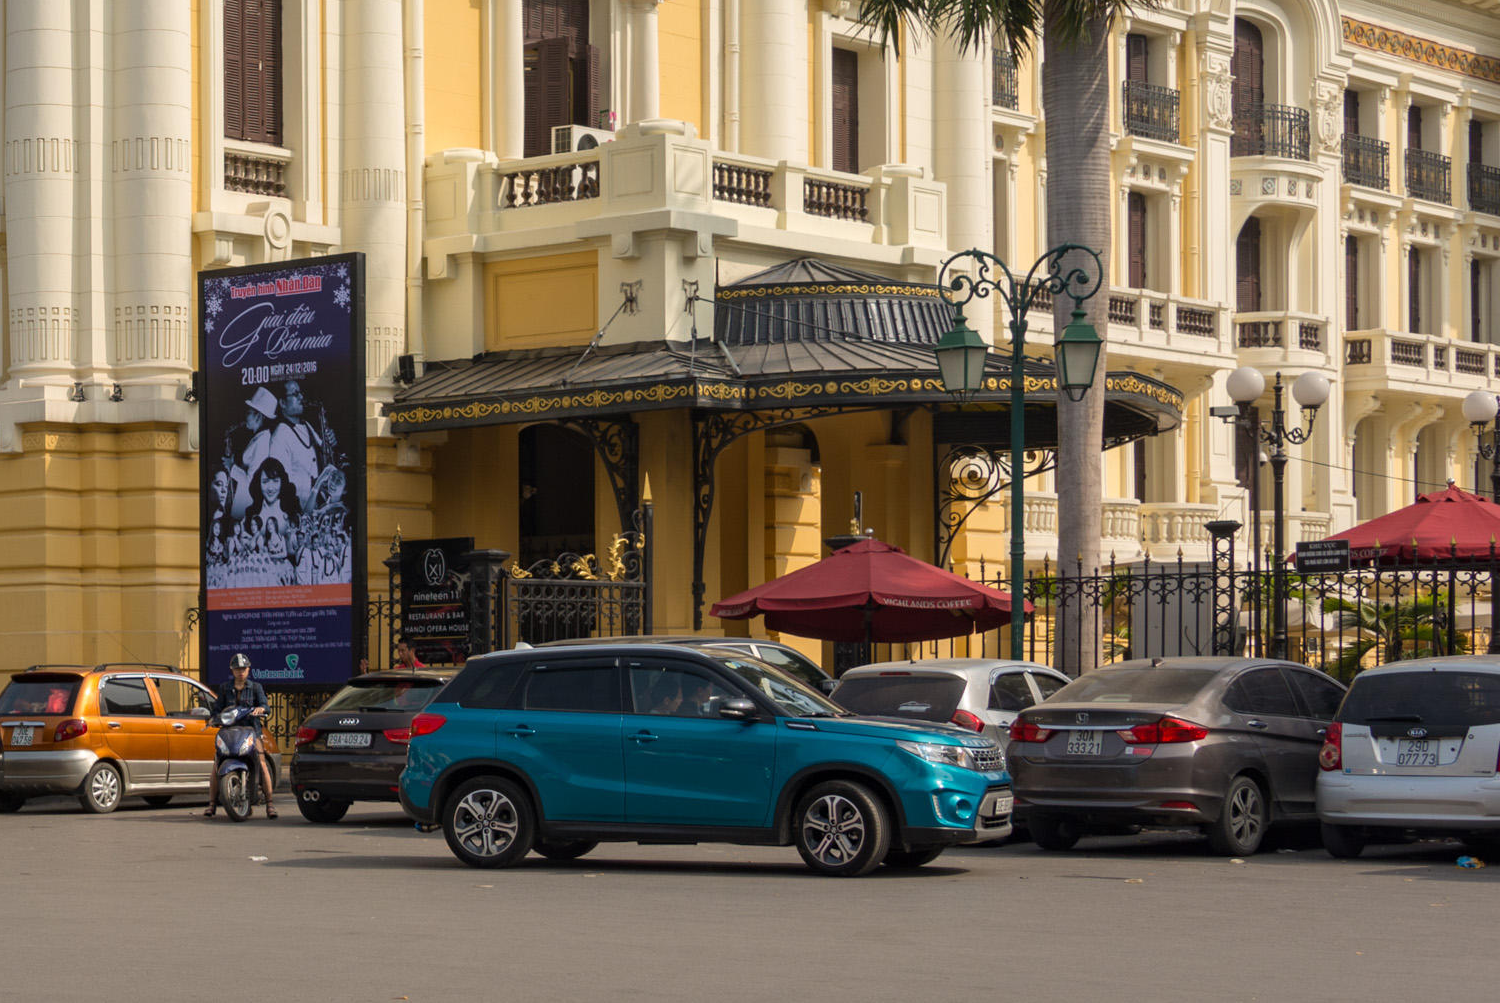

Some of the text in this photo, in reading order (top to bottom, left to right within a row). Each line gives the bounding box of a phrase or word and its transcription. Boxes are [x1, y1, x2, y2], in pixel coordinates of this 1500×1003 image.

[264, 326, 302, 359] Bốn
[241, 366, 269, 385] 20:00
[413, 591, 459, 602] nineteen 11
[936, 599, 972, 609] COFFEE
[408, 612, 445, 621] RESTAURANT
[452, 611, 465, 619] BAR
[405, 624, 469, 633] HANOI OPERA HOUSE
[251, 668, 304, 679] Vietcombank
[1076, 730, 1094, 742] 30A
[1067, 742, 1101, 755] 333.21
[1407, 740, 1428, 753] 29D
[1397, 753, 1436, 766] 077.73
